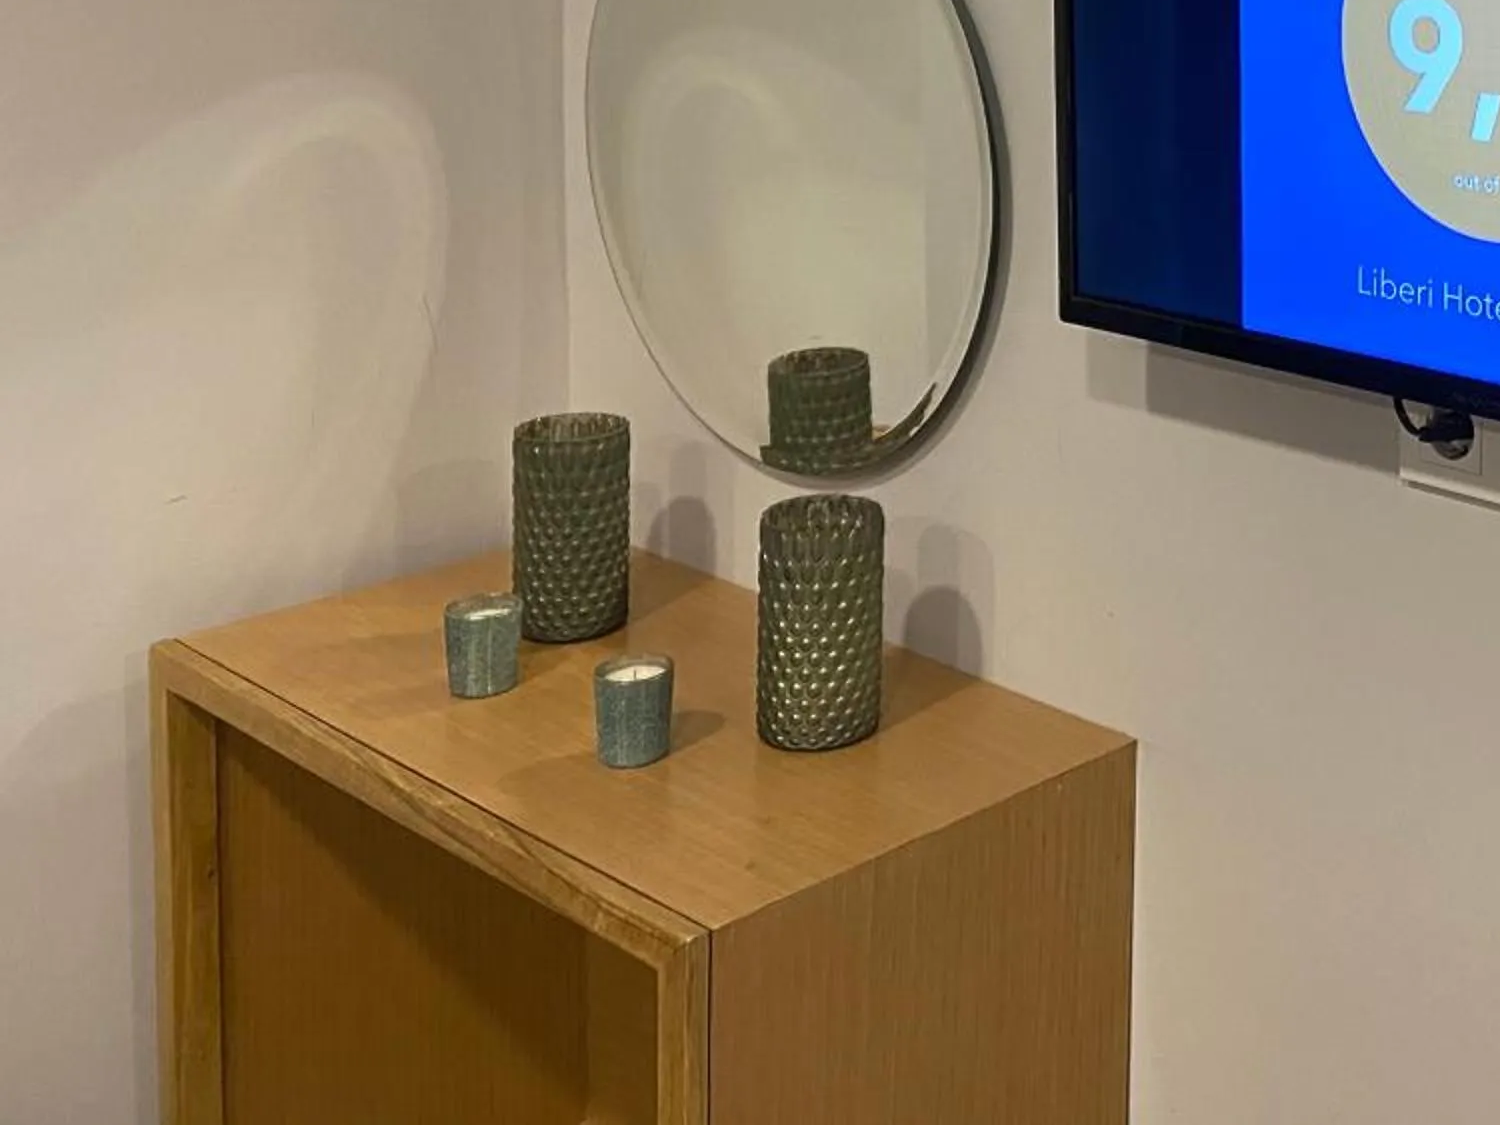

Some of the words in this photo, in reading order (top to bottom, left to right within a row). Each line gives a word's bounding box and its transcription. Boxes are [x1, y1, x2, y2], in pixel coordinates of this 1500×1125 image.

[1454, 174, 1479, 192] out
[1484, 175, 1499, 195] of
[1357, 265, 1434, 308] Liberi
